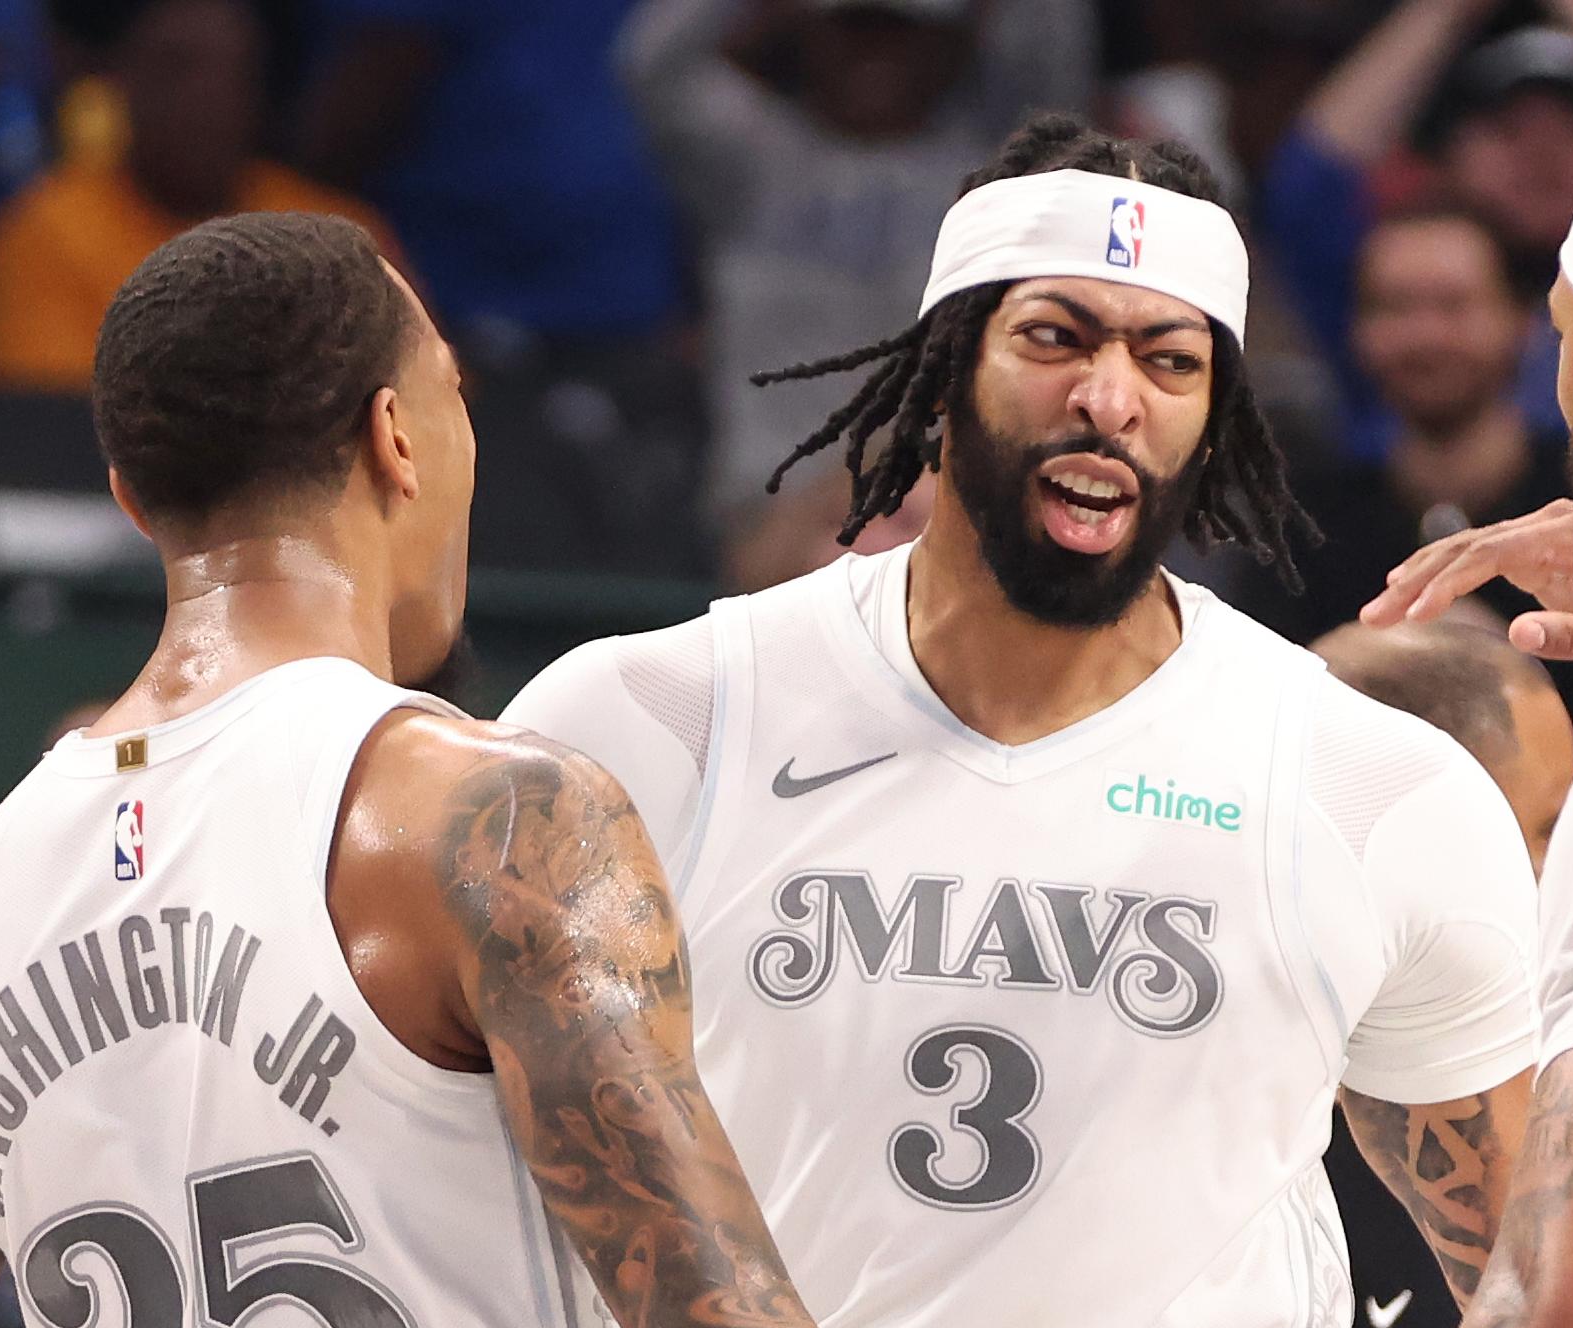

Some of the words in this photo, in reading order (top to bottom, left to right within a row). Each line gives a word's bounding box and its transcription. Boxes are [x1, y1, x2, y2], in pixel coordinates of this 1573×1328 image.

[1107, 774, 1242, 832] chime
[746, 869, 1225, 1039] MAVS
[253, 992, 357, 1138] JR.
[886, 1021, 1044, 1212] 3
